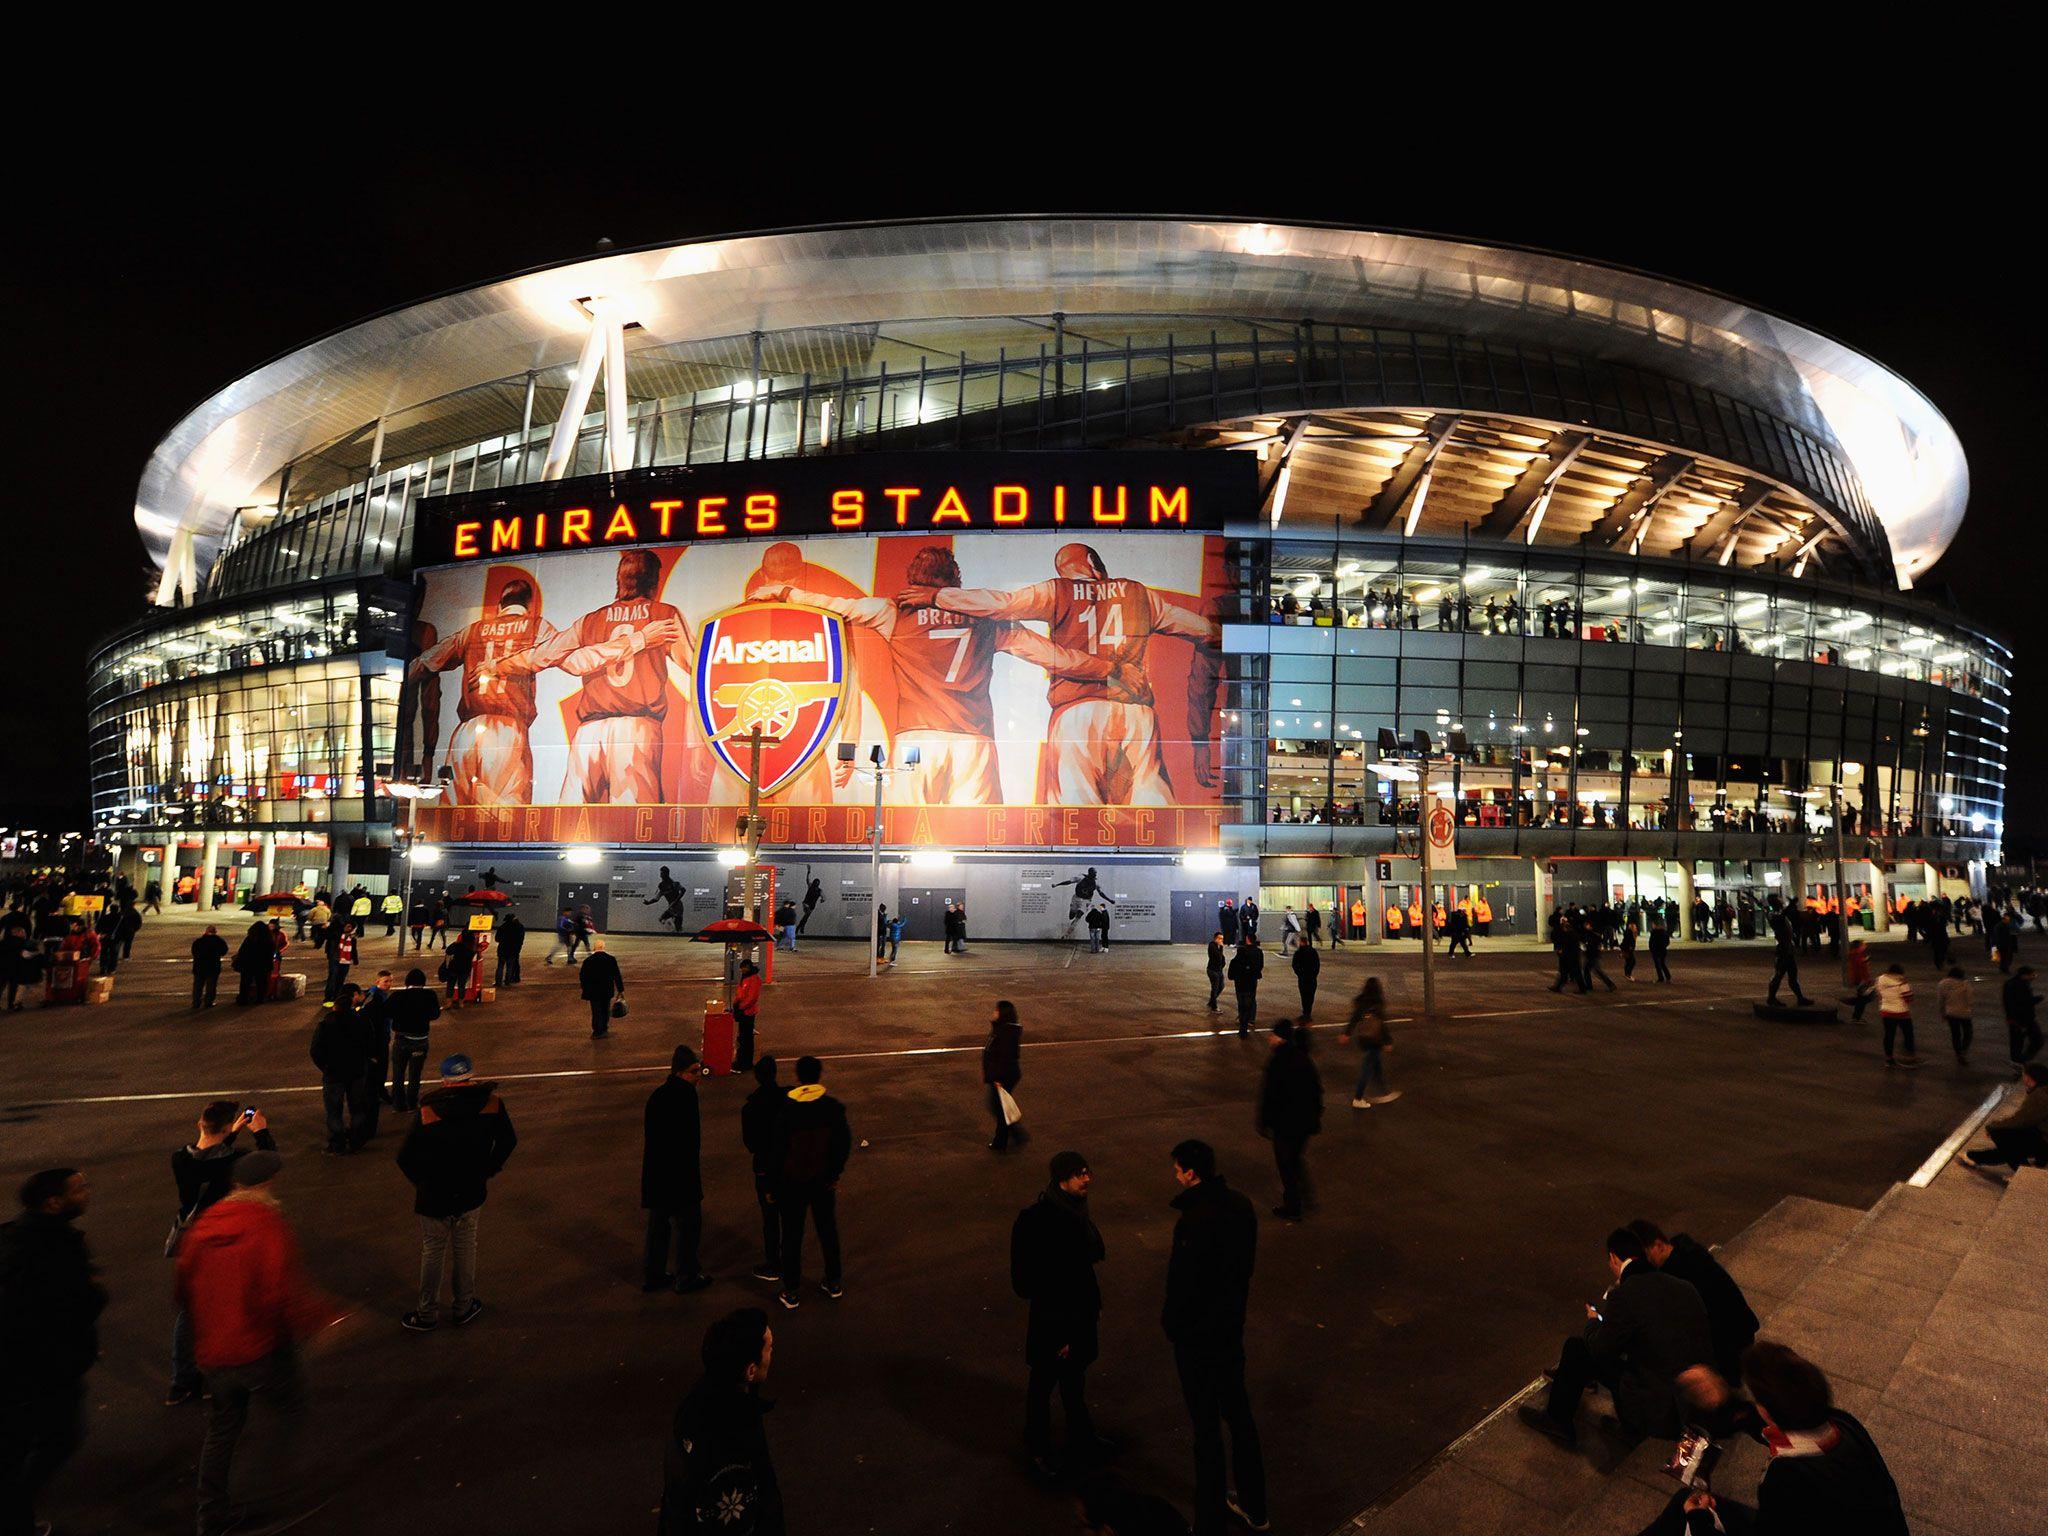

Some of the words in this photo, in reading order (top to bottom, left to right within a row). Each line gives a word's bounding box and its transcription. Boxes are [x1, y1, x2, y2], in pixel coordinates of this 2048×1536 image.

[454, 494, 779, 557] EMIRATES
[830, 485, 1191, 527] STADIUM
[1072, 581, 1128, 602] HENRY
[605, 603, 651, 622] ADAMS
[480, 619, 530, 637] BASTIN
[1078, 602, 1128, 656] 14
[712, 632, 827, 664] Arsenal
[928, 628, 972, 683] 7
[986, 808, 1223, 846] CRESCIT
[143, 851, 156, 863] G
[241, 852, 252, 865] F
[1380, 864, 1386, 879] E
